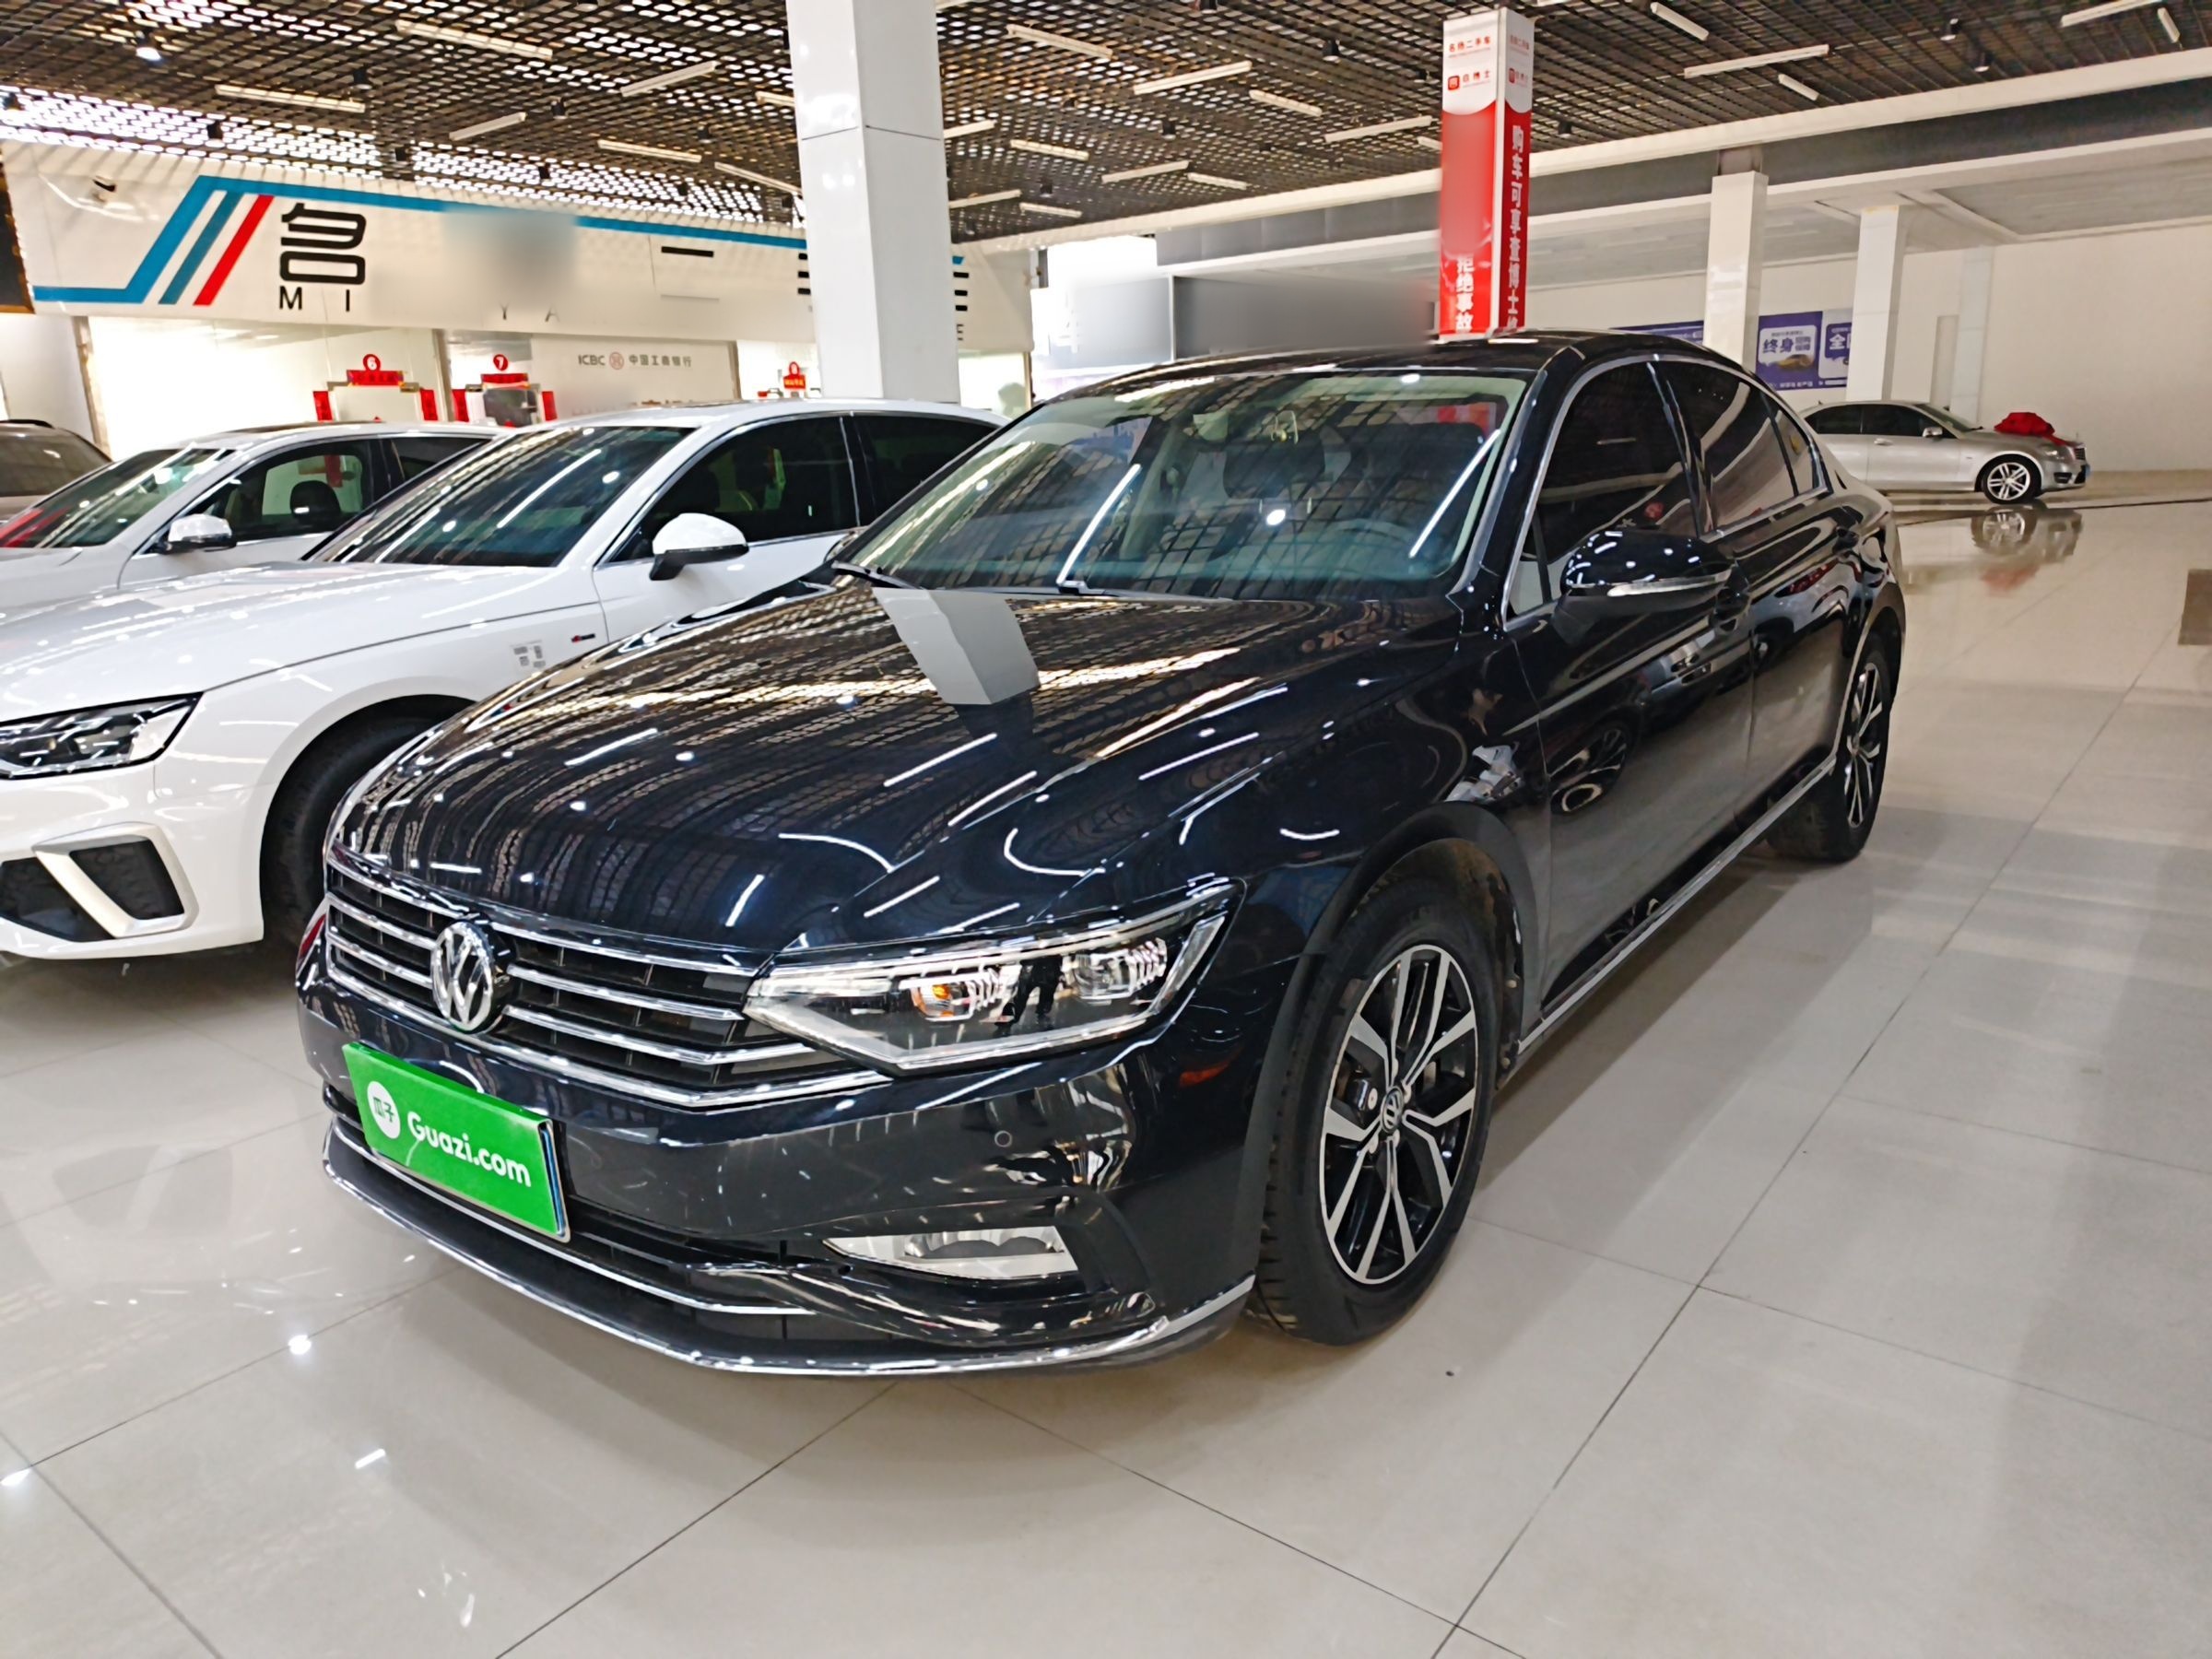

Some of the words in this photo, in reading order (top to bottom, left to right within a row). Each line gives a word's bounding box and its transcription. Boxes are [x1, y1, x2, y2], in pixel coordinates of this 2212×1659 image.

[1829, 333, 1851, 350] 全
[367, 356, 378, 371] 6
[496, 357, 504, 370] 7
[578, 354, 606, 366] ICBC
[629, 354, 691, 367] 中国工商银行
[406, 1111, 532, 1188] Guazi.com
